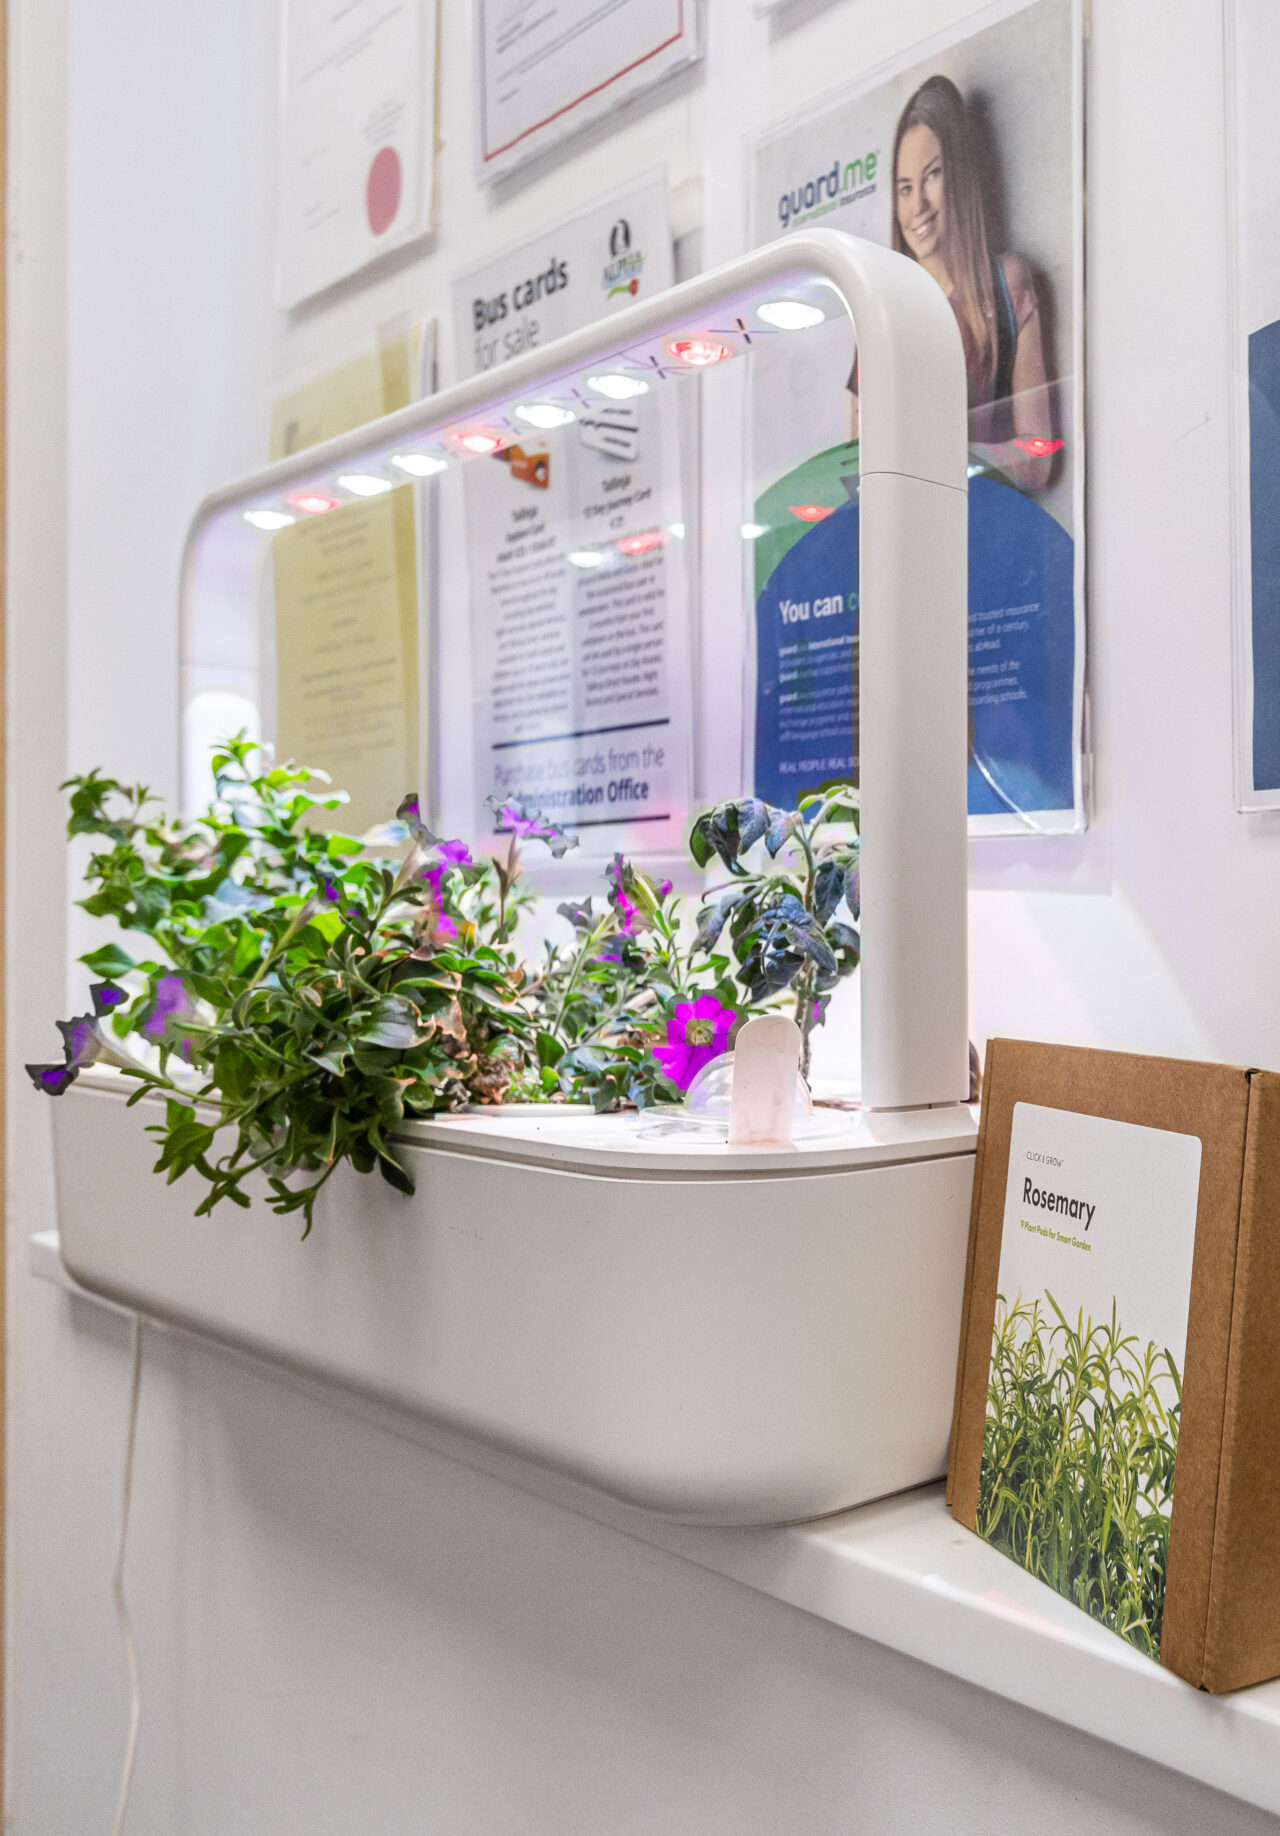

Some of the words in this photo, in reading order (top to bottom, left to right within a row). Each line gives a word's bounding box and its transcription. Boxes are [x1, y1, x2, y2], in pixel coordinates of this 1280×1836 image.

[778, 151, 878, 229] guard.me
[473, 291, 508, 332] Bus
[512, 256, 569, 311] cards
[502, 315, 541, 359] sale
[779, 599, 810, 625] You
[812, 594, 844, 618] can
[641, 744, 665, 769] the
[607, 778, 649, 802] Office
[1023, 1176, 1096, 1231] Rosemary
